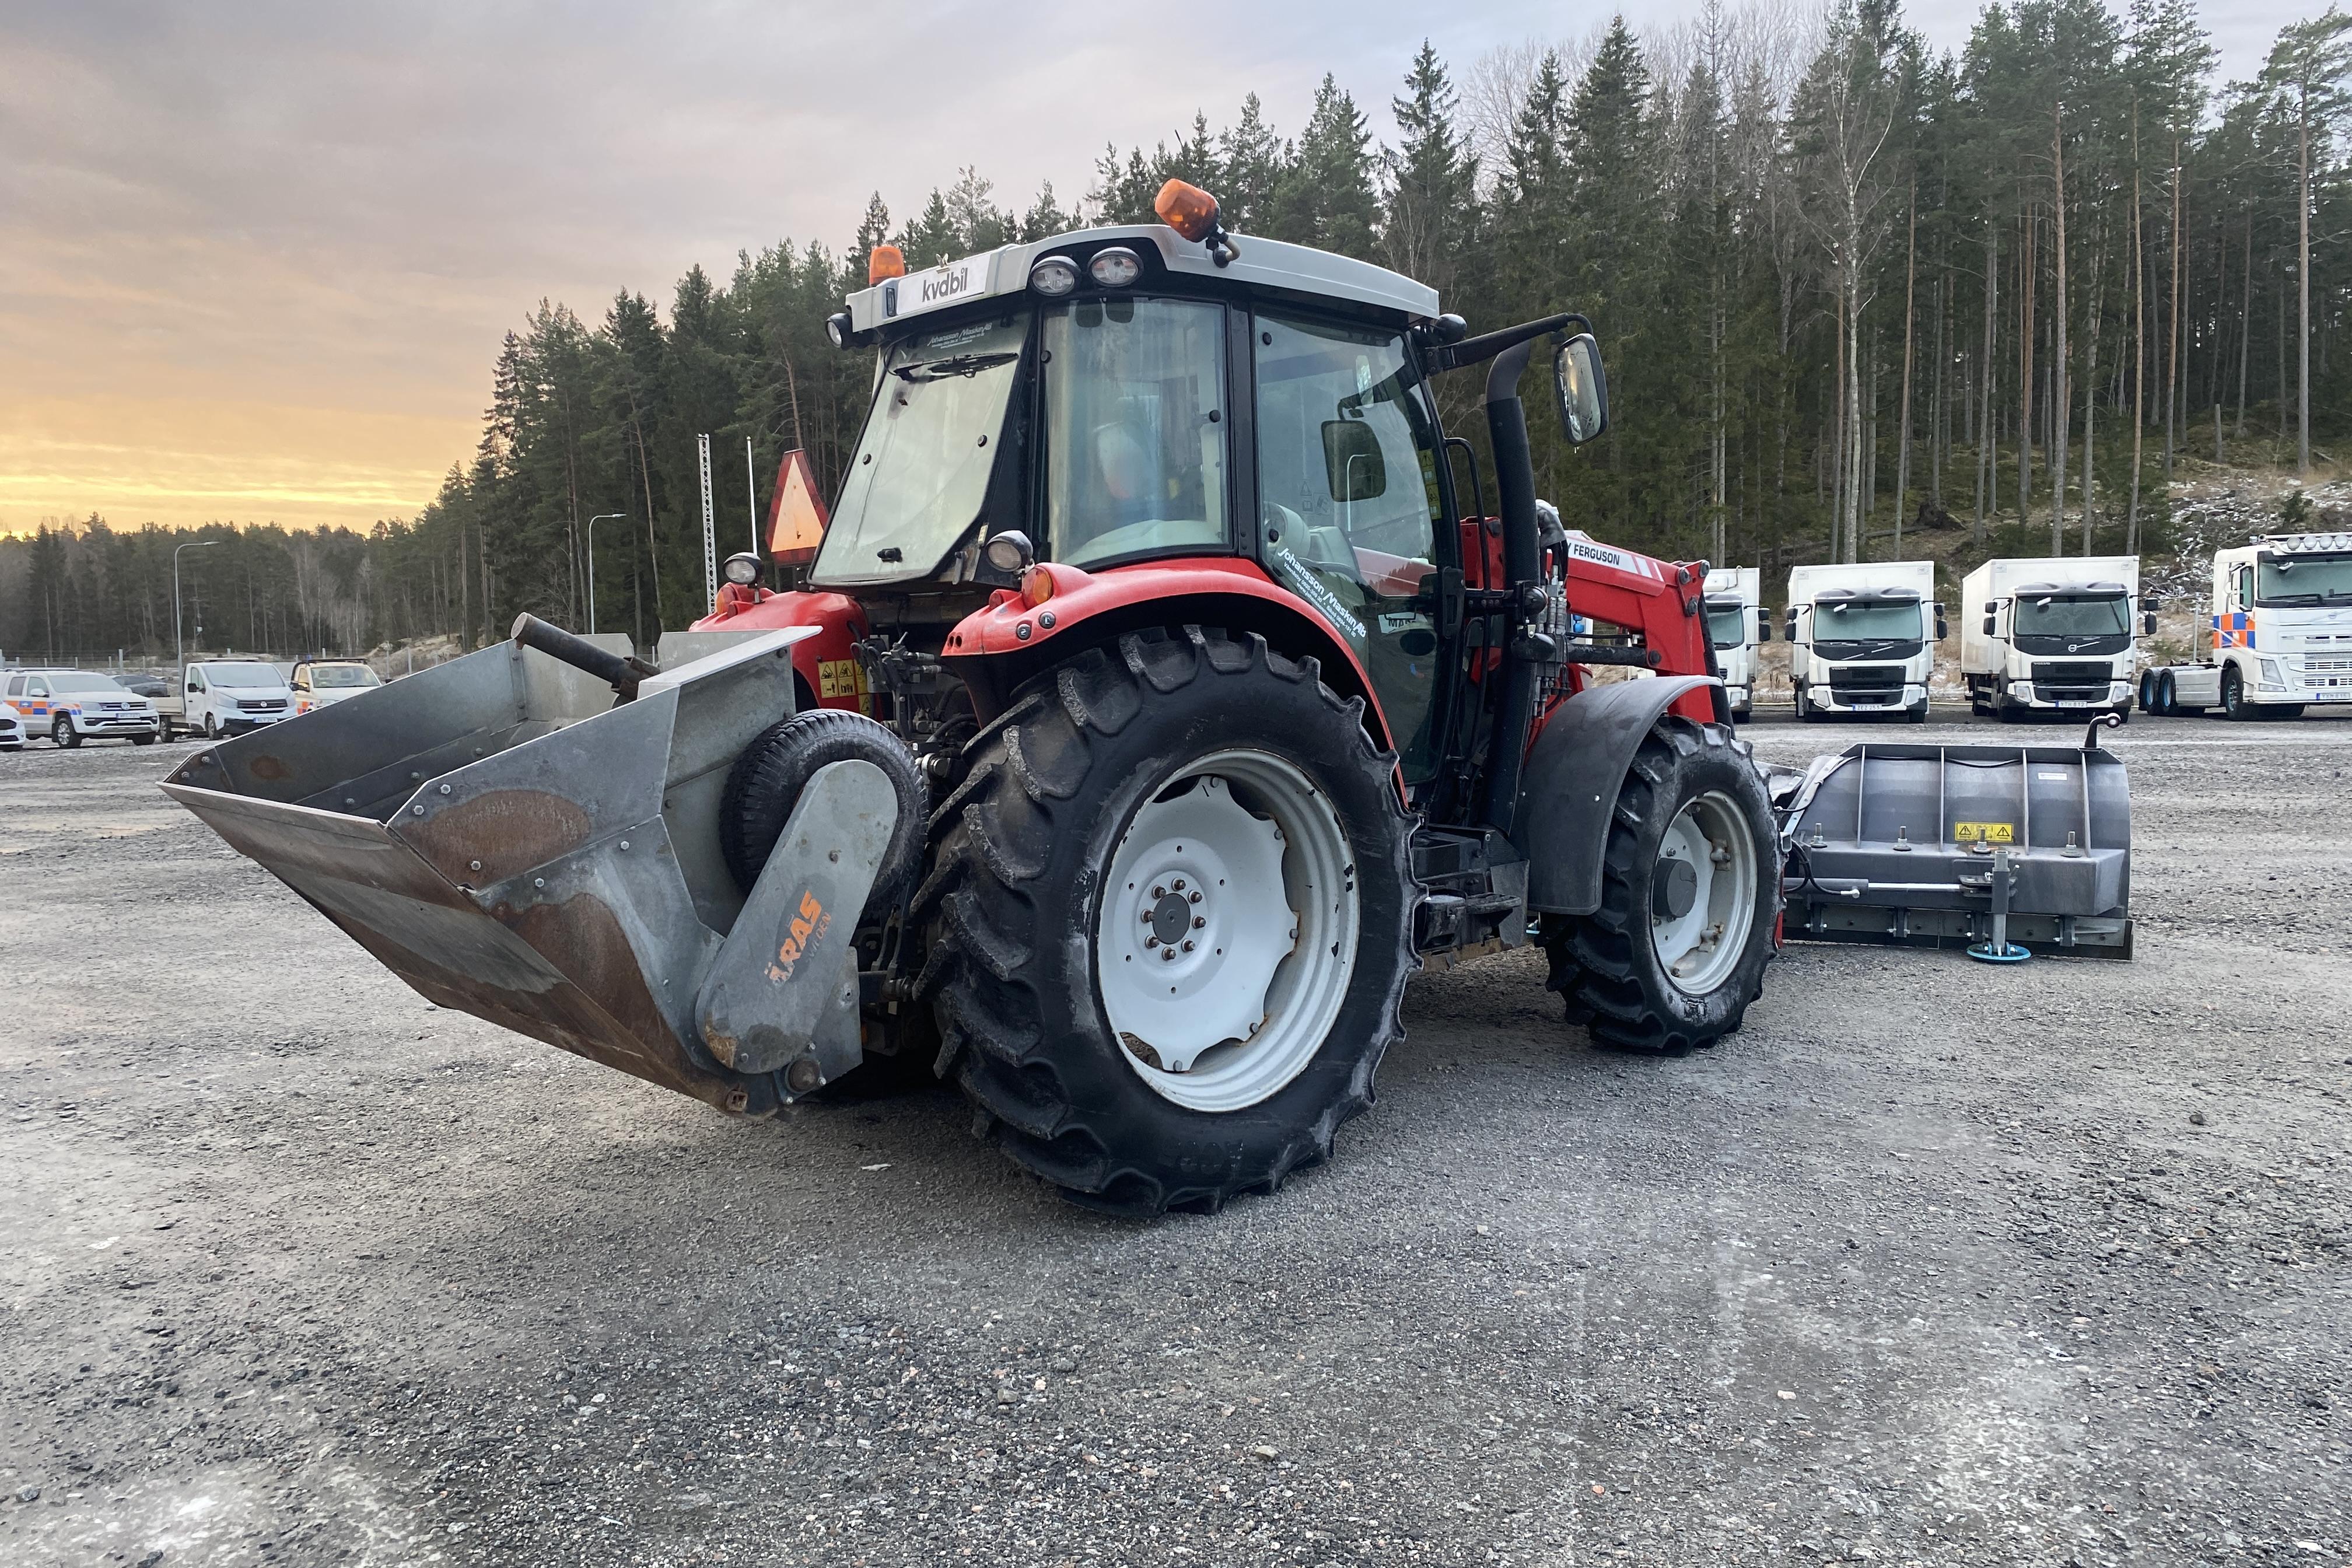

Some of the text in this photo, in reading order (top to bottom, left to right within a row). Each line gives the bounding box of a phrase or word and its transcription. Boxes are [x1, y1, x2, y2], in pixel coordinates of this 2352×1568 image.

[922, 267, 968, 302] kvdbil
[1574, 544, 1620, 565] FERGUSON
[1278, 547, 1325, 595] Johansson
[1323, 592, 1357, 628] Maskin
